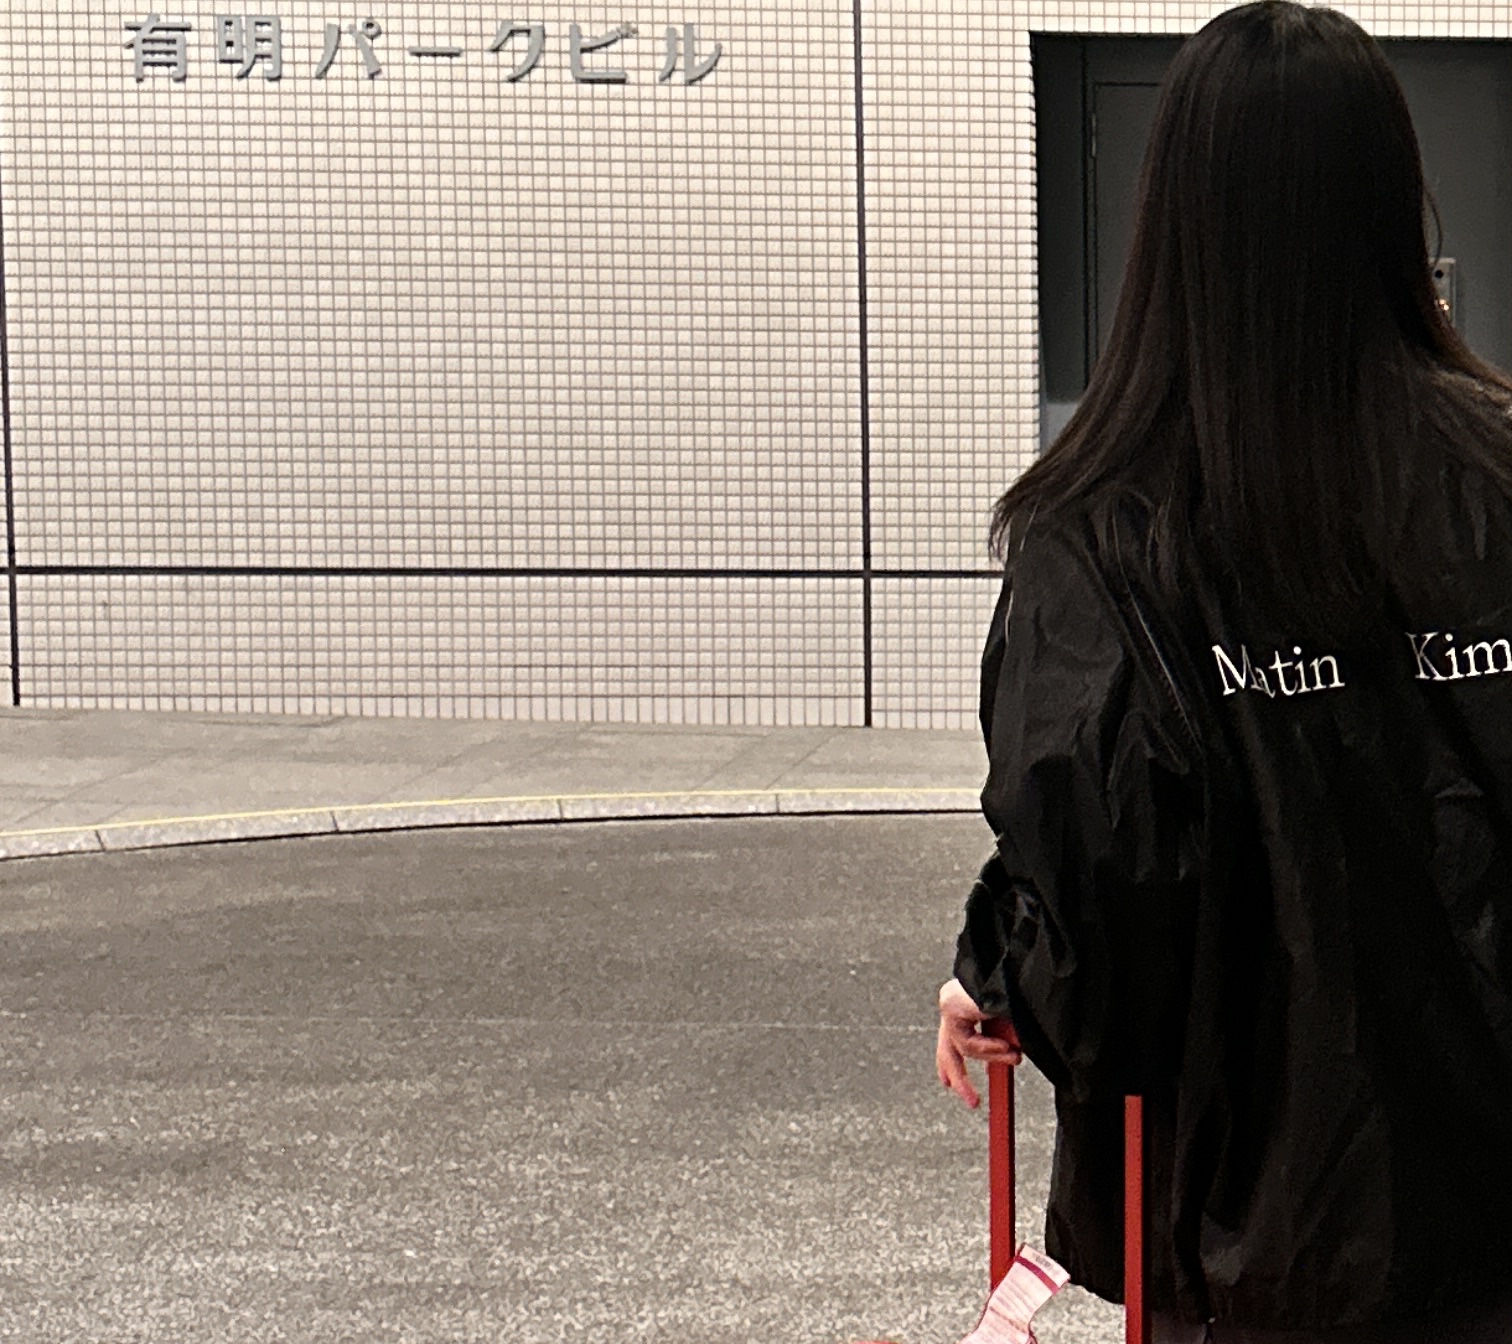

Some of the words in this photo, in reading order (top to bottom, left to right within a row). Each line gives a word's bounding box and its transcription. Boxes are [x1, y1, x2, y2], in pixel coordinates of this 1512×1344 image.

[124, 13, 722, 86] 有明パークビル
